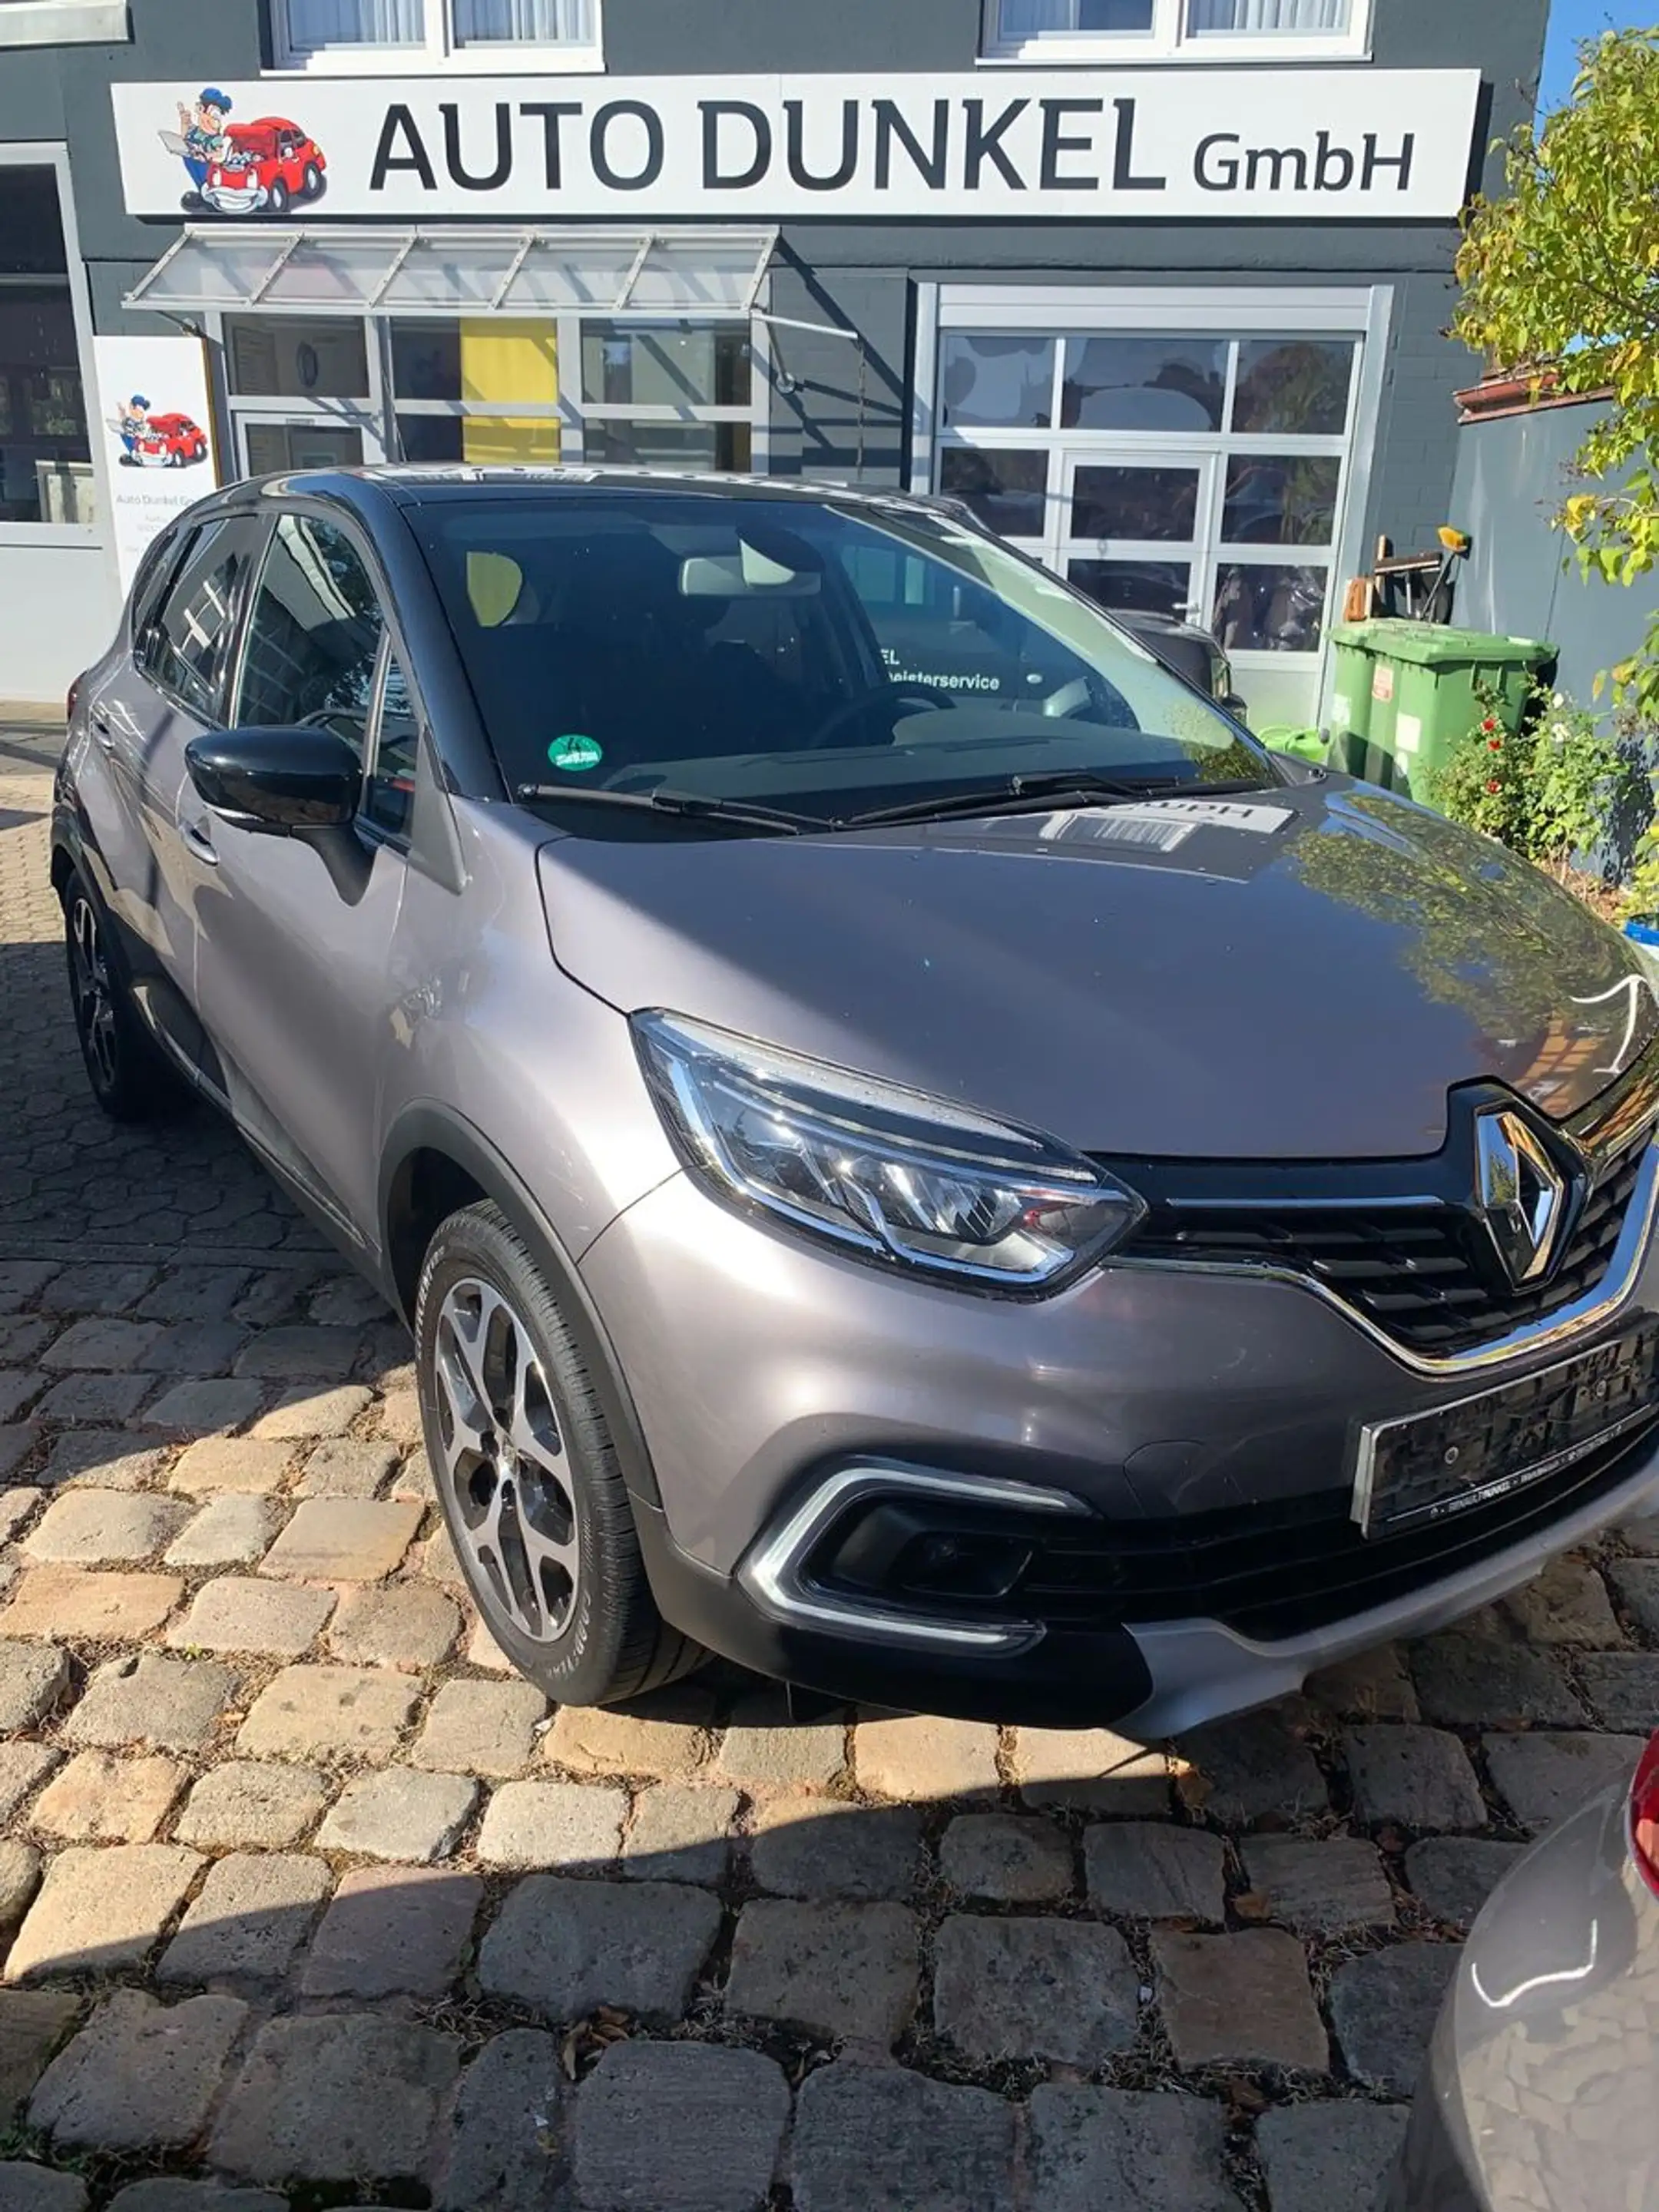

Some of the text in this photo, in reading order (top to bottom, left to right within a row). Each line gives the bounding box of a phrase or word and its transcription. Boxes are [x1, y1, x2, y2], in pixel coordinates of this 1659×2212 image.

[369, 98, 1416, 191] AUTO DUNKEL GmbH
[116, 494, 141, 505] Auto
